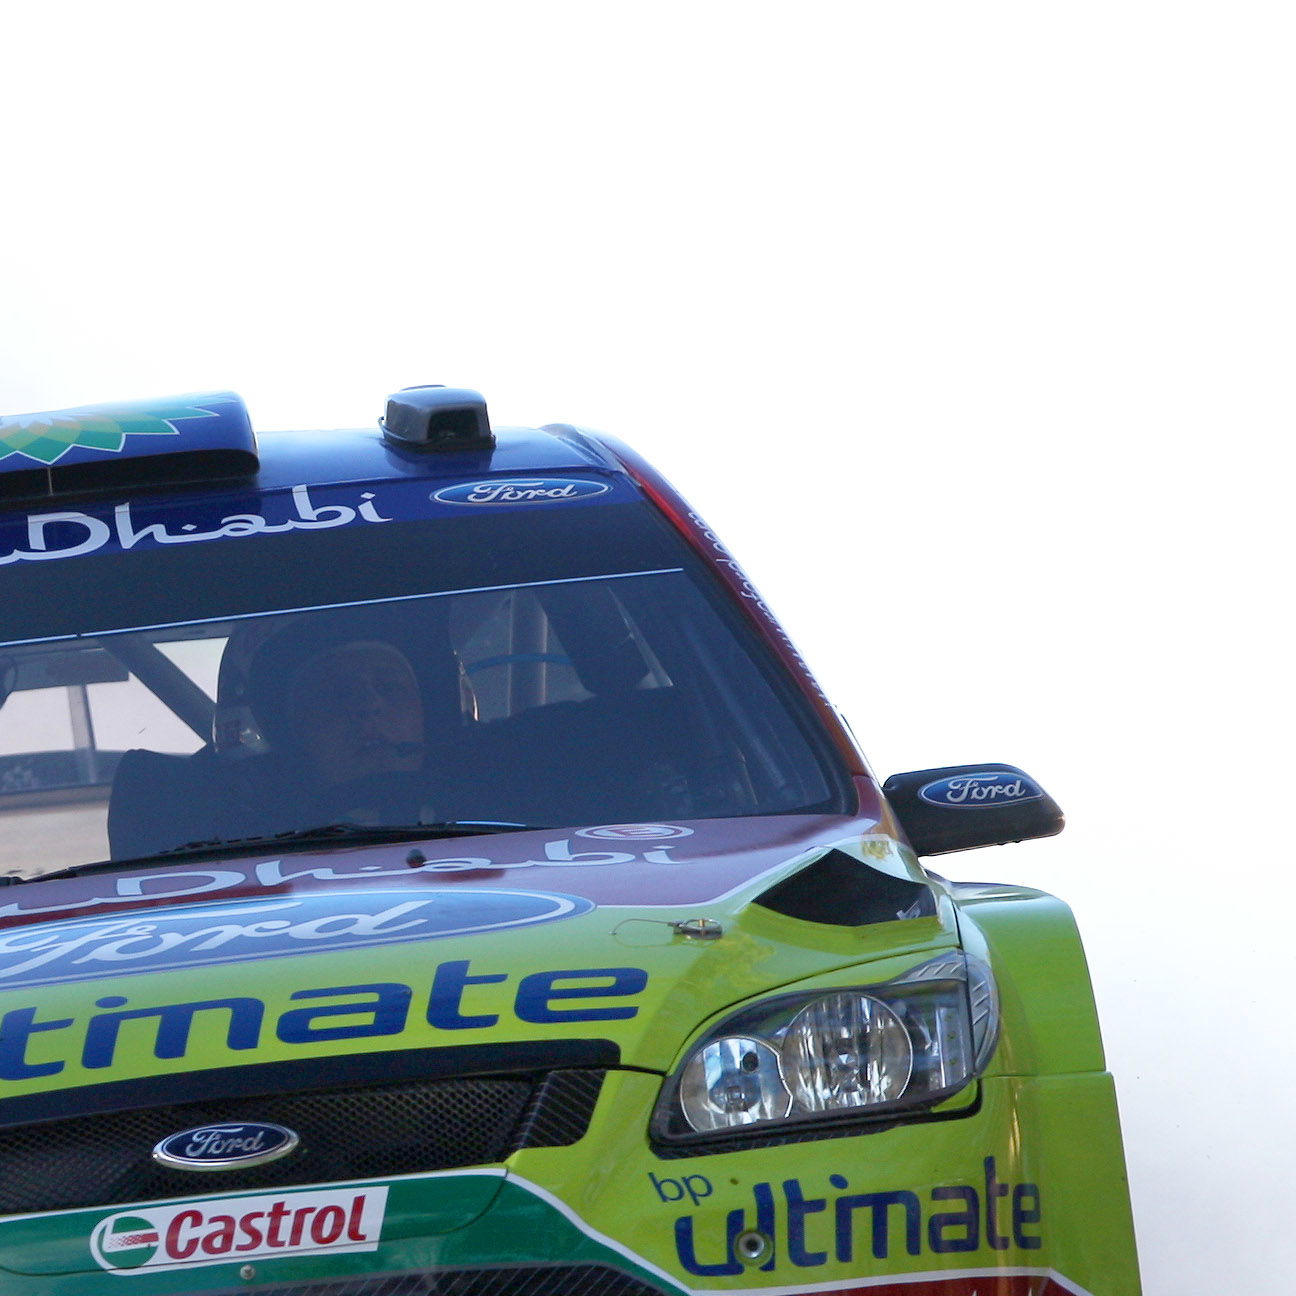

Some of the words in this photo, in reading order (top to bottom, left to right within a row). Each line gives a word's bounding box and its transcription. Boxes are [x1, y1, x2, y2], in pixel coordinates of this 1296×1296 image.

[468, 480, 580, 502] Ford
[19, 484, 394, 562] Dhabi
[946, 772, 1026, 803] Ford
[94, 839, 683, 902] Dhabi
[185, 1127, 265, 1156] Ford
[648, 1172, 713, 1206] bp
[165, 1195, 367, 1261] Castrol
[674, 1155, 1042, 1278] ultimate
